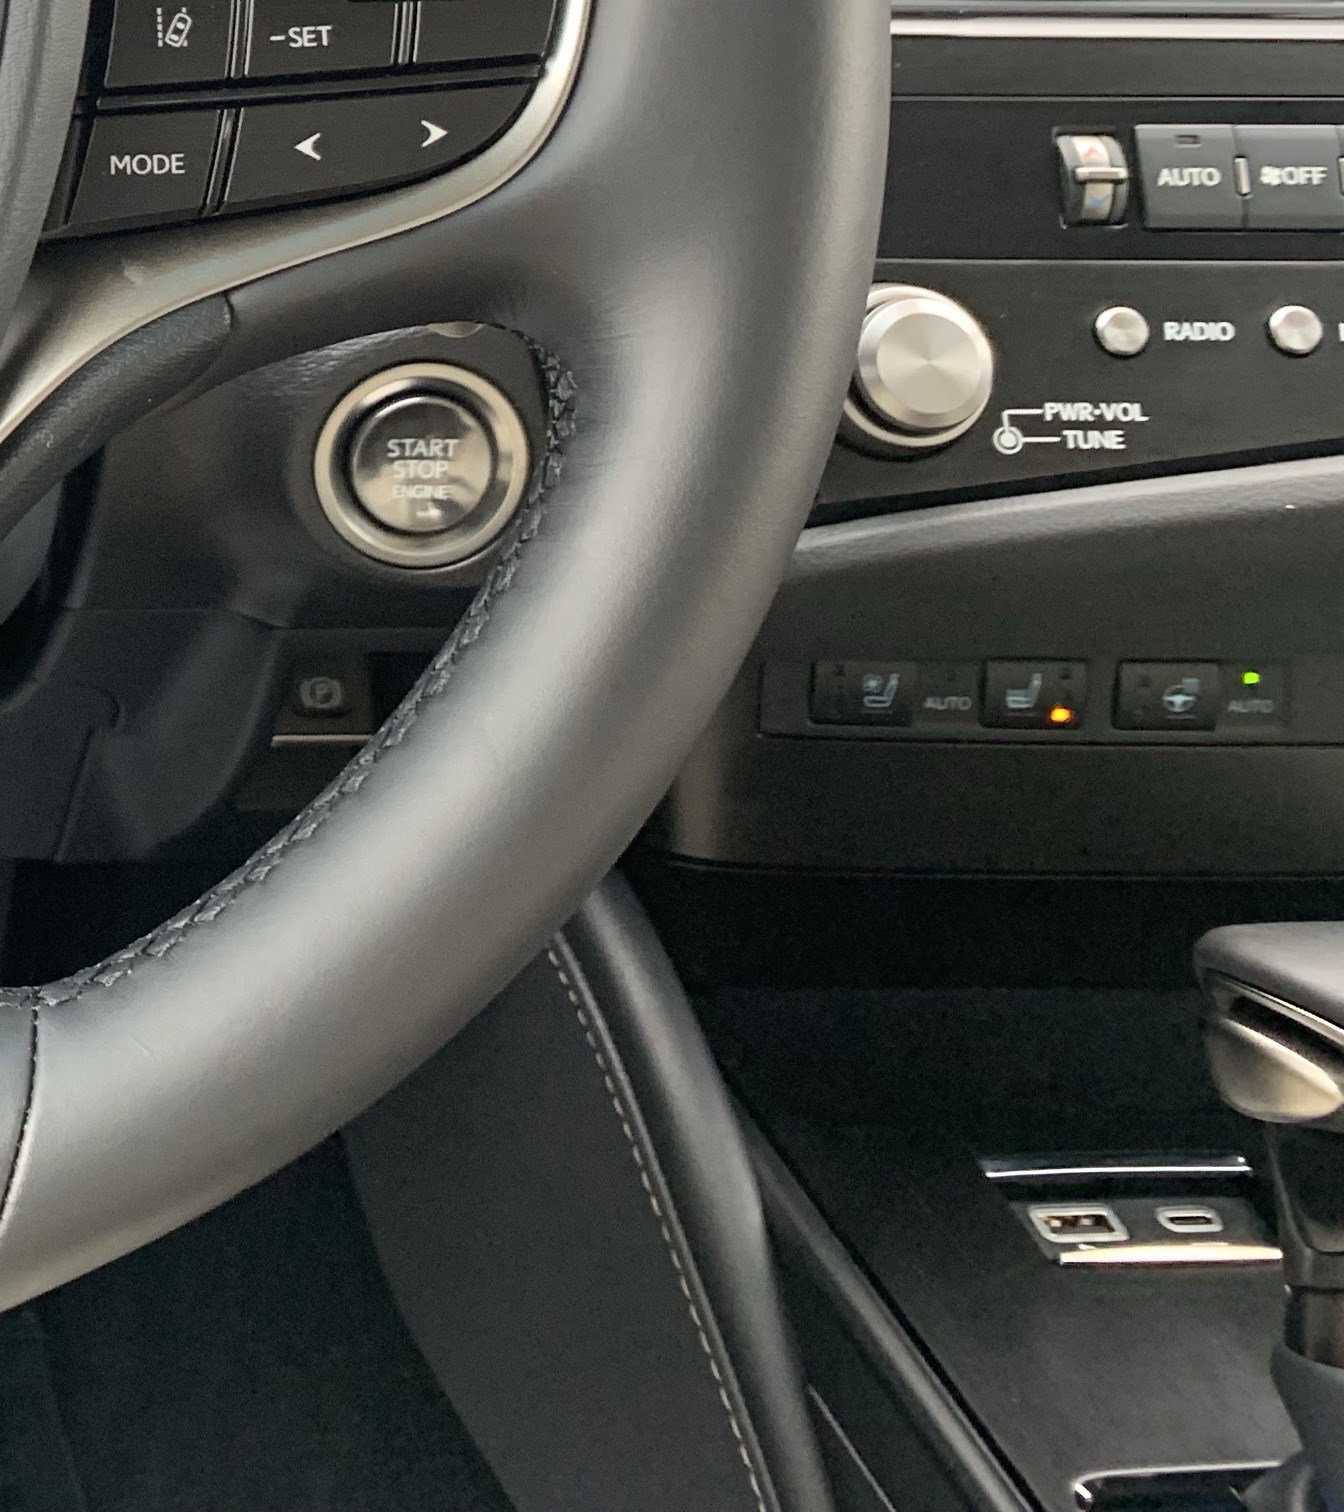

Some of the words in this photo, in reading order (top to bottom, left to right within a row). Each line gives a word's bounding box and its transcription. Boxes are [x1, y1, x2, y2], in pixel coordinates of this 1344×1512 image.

[109, 153, 186, 176] MODE
[1157, 167, 1222, 186] AUTO
[1281, 166, 1329, 186] OFF
[1163, 321, 1236, 341] RADIO
[387, 438, 460, 458] START
[1062, 429, 1127, 449] TUNE
[392, 460, 450, 480] STOP
[391, 484, 451, 500] ENGINE
[923, 695, 972, 711] AUTO
[1226, 697, 1275, 714] AUTO
